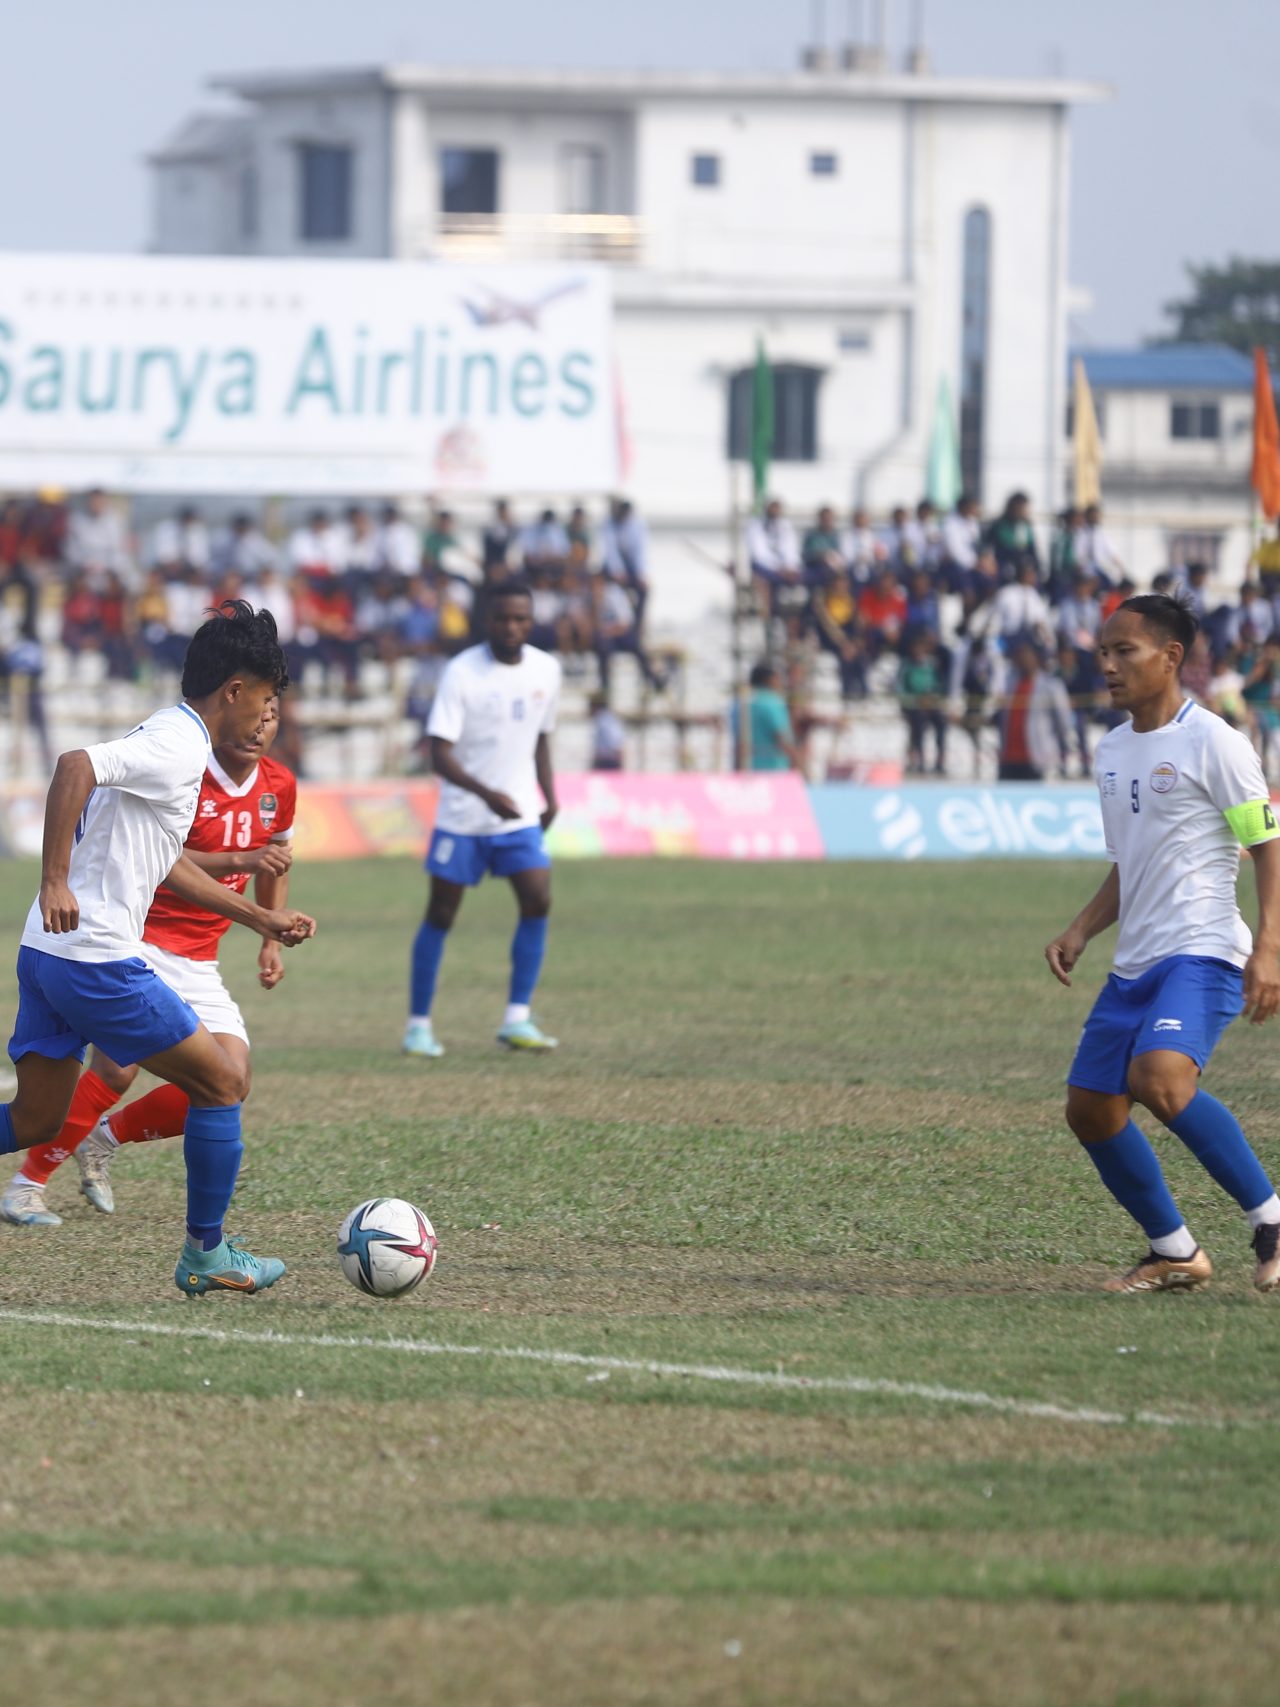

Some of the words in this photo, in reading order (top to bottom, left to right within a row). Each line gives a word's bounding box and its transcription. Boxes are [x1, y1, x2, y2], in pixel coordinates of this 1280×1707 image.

[286, 322, 596, 418] Airlines
[1131, 779, 1140, 813] 9
[221, 810, 252, 848] 13
[937, 790, 1107, 853] elica
